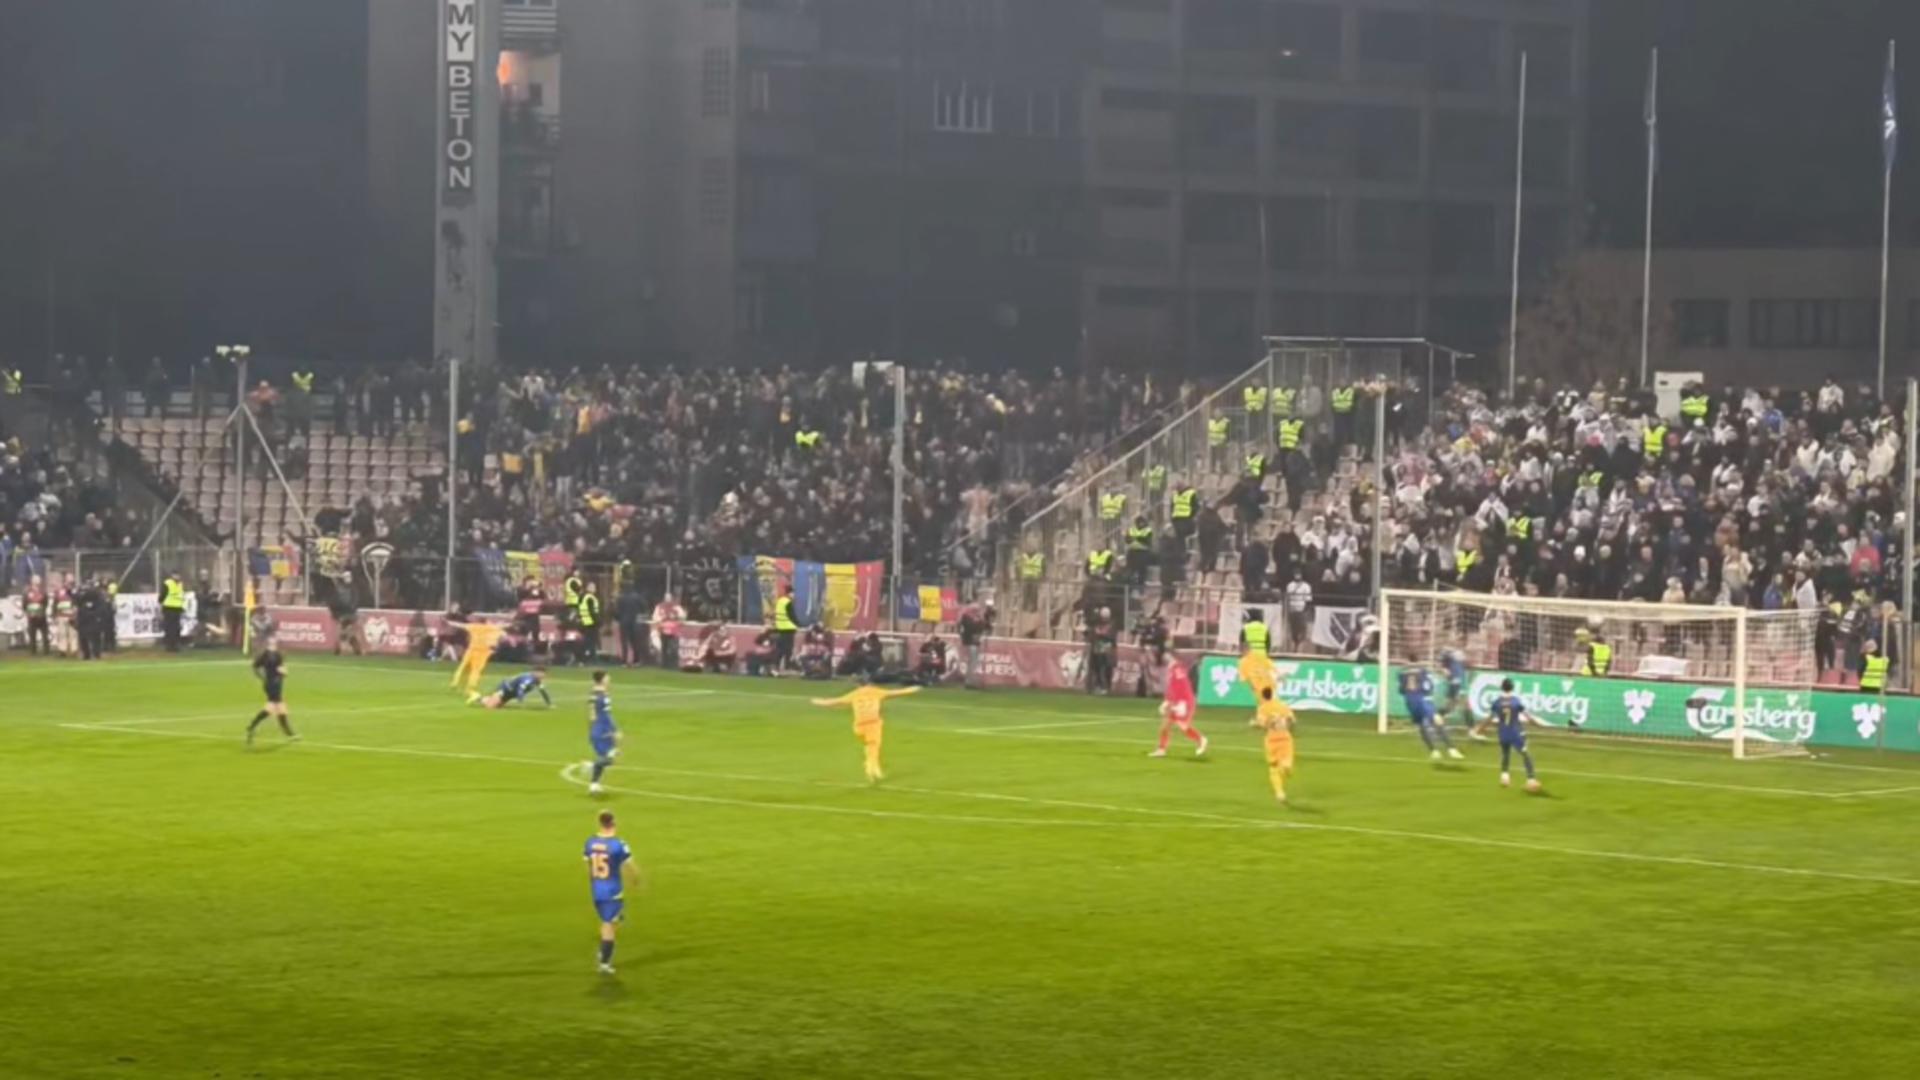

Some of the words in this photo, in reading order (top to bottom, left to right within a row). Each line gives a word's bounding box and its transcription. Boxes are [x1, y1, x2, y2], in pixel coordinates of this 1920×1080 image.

[448, 65, 472, 188] BETON
[1684, 687, 1816, 740] Carsberg
[590, 852, 609, 879] 15
